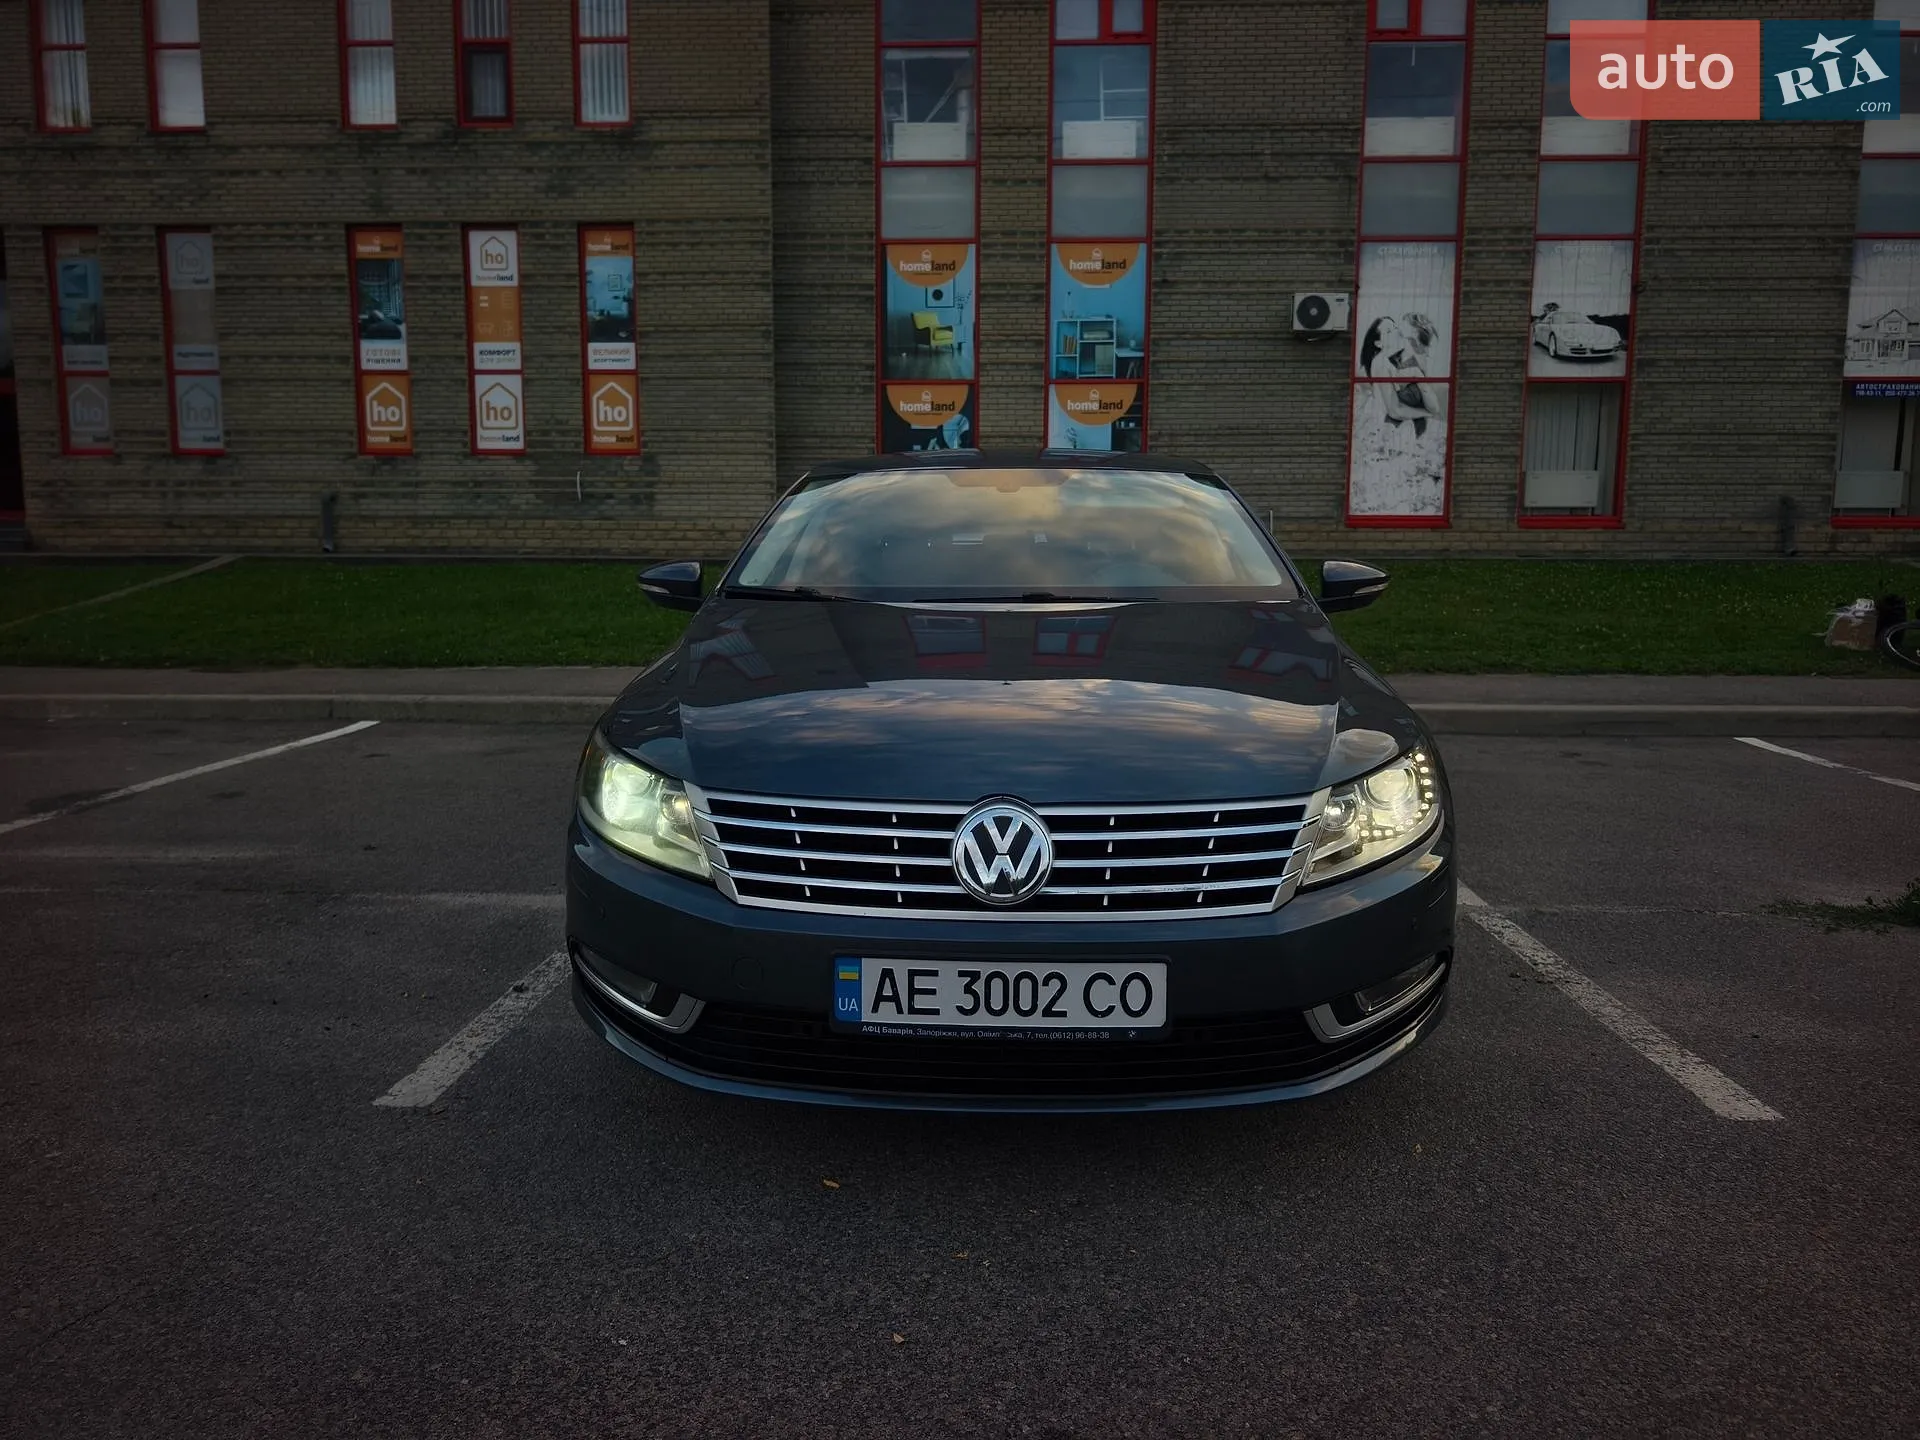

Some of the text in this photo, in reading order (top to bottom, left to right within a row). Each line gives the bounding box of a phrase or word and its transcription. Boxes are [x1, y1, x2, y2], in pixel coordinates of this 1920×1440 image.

[485, 249, 504, 264] ho
[899, 260, 956, 272] homeland
[1069, 259, 1126, 271] homeland
[372, 400, 400, 422] ho
[486, 400, 512, 421] ho
[599, 399, 627, 422] ho
[899, 400, 955, 412] homeland
[1067, 400, 1123, 411] homeland
[870, 967, 1153, 1018] AE 3002 CO
[838, 997, 858, 1011] UA
[861, 1025, 880, 1034] АФЦ
